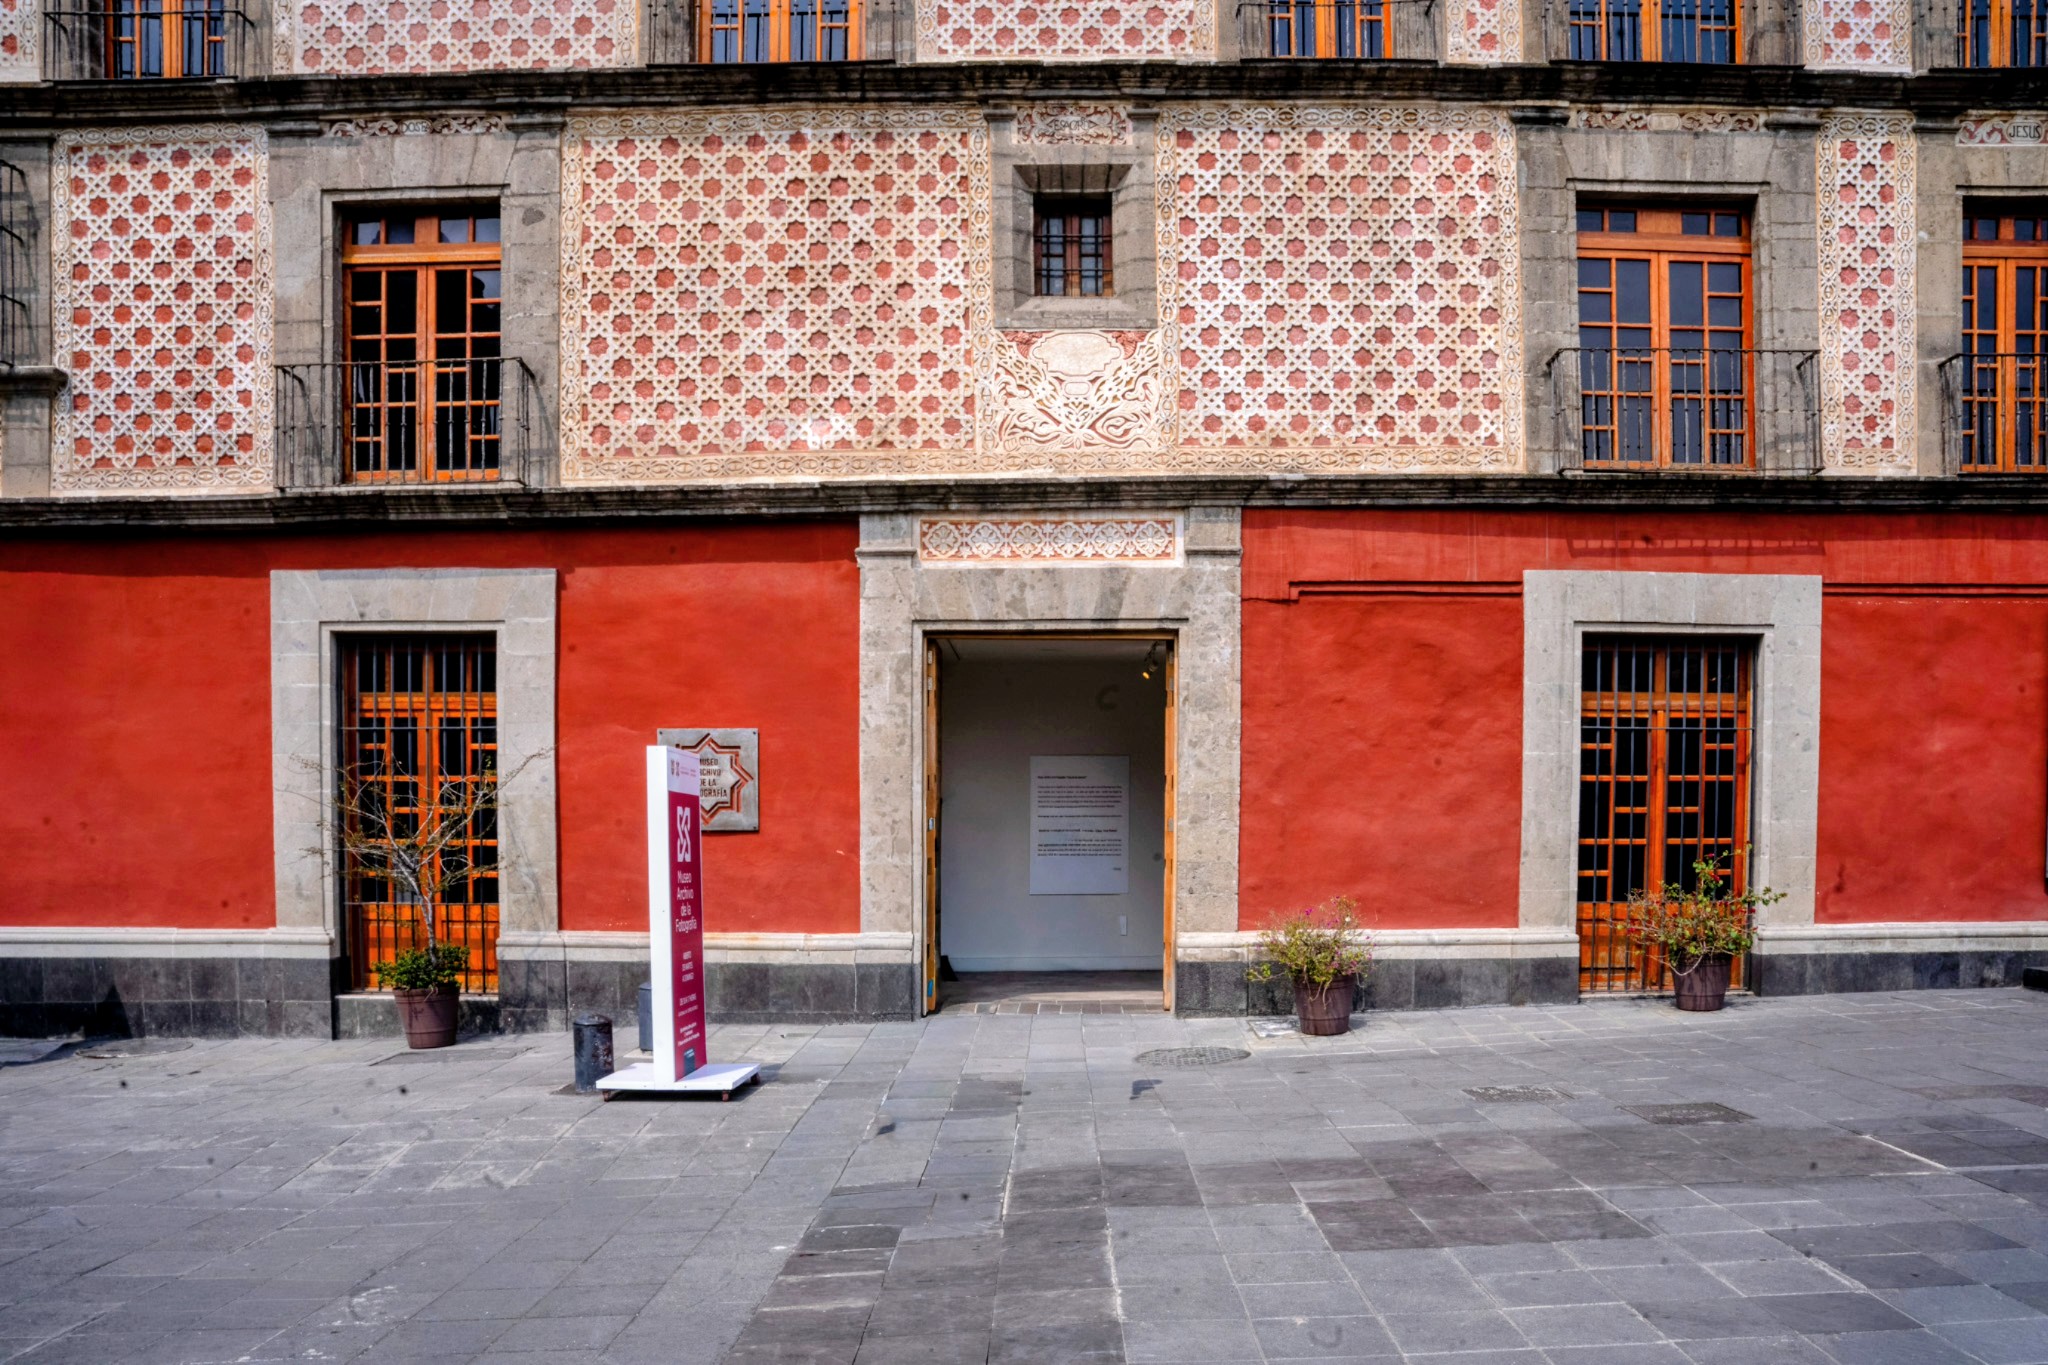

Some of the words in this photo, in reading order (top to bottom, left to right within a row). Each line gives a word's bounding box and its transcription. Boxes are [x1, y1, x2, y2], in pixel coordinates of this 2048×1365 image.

[2009, 125, 2041, 138] JESUS
[700, 768, 722, 776] RCHIVO
[708, 778, 717, 787] LA
[700, 787, 728, 797] OGRAFÍA
[677, 870, 692, 883] Museo
[677, 885, 694, 900] Archivo
